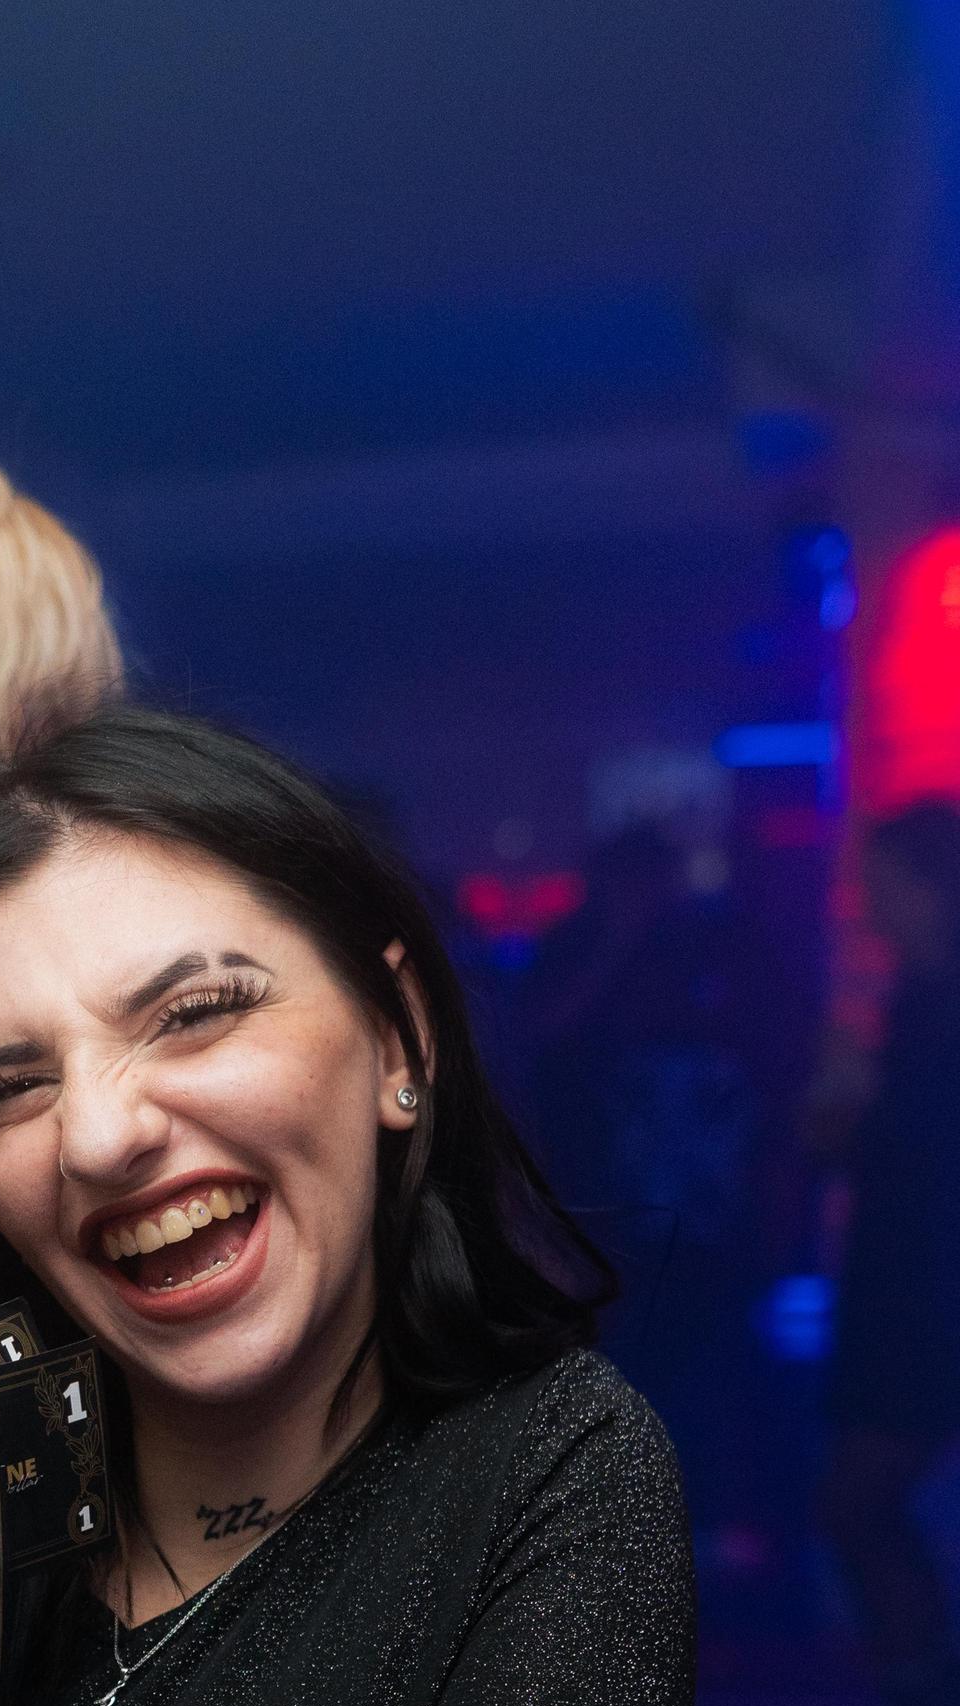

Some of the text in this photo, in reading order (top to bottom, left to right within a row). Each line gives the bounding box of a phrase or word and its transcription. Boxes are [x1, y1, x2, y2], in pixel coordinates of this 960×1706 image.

[62, 1380, 87, 1424] 1
[5, 1458, 37, 1485] NE
[7, 1474, 44, 1494] ollar
[78, 1505, 94, 1532] 1
